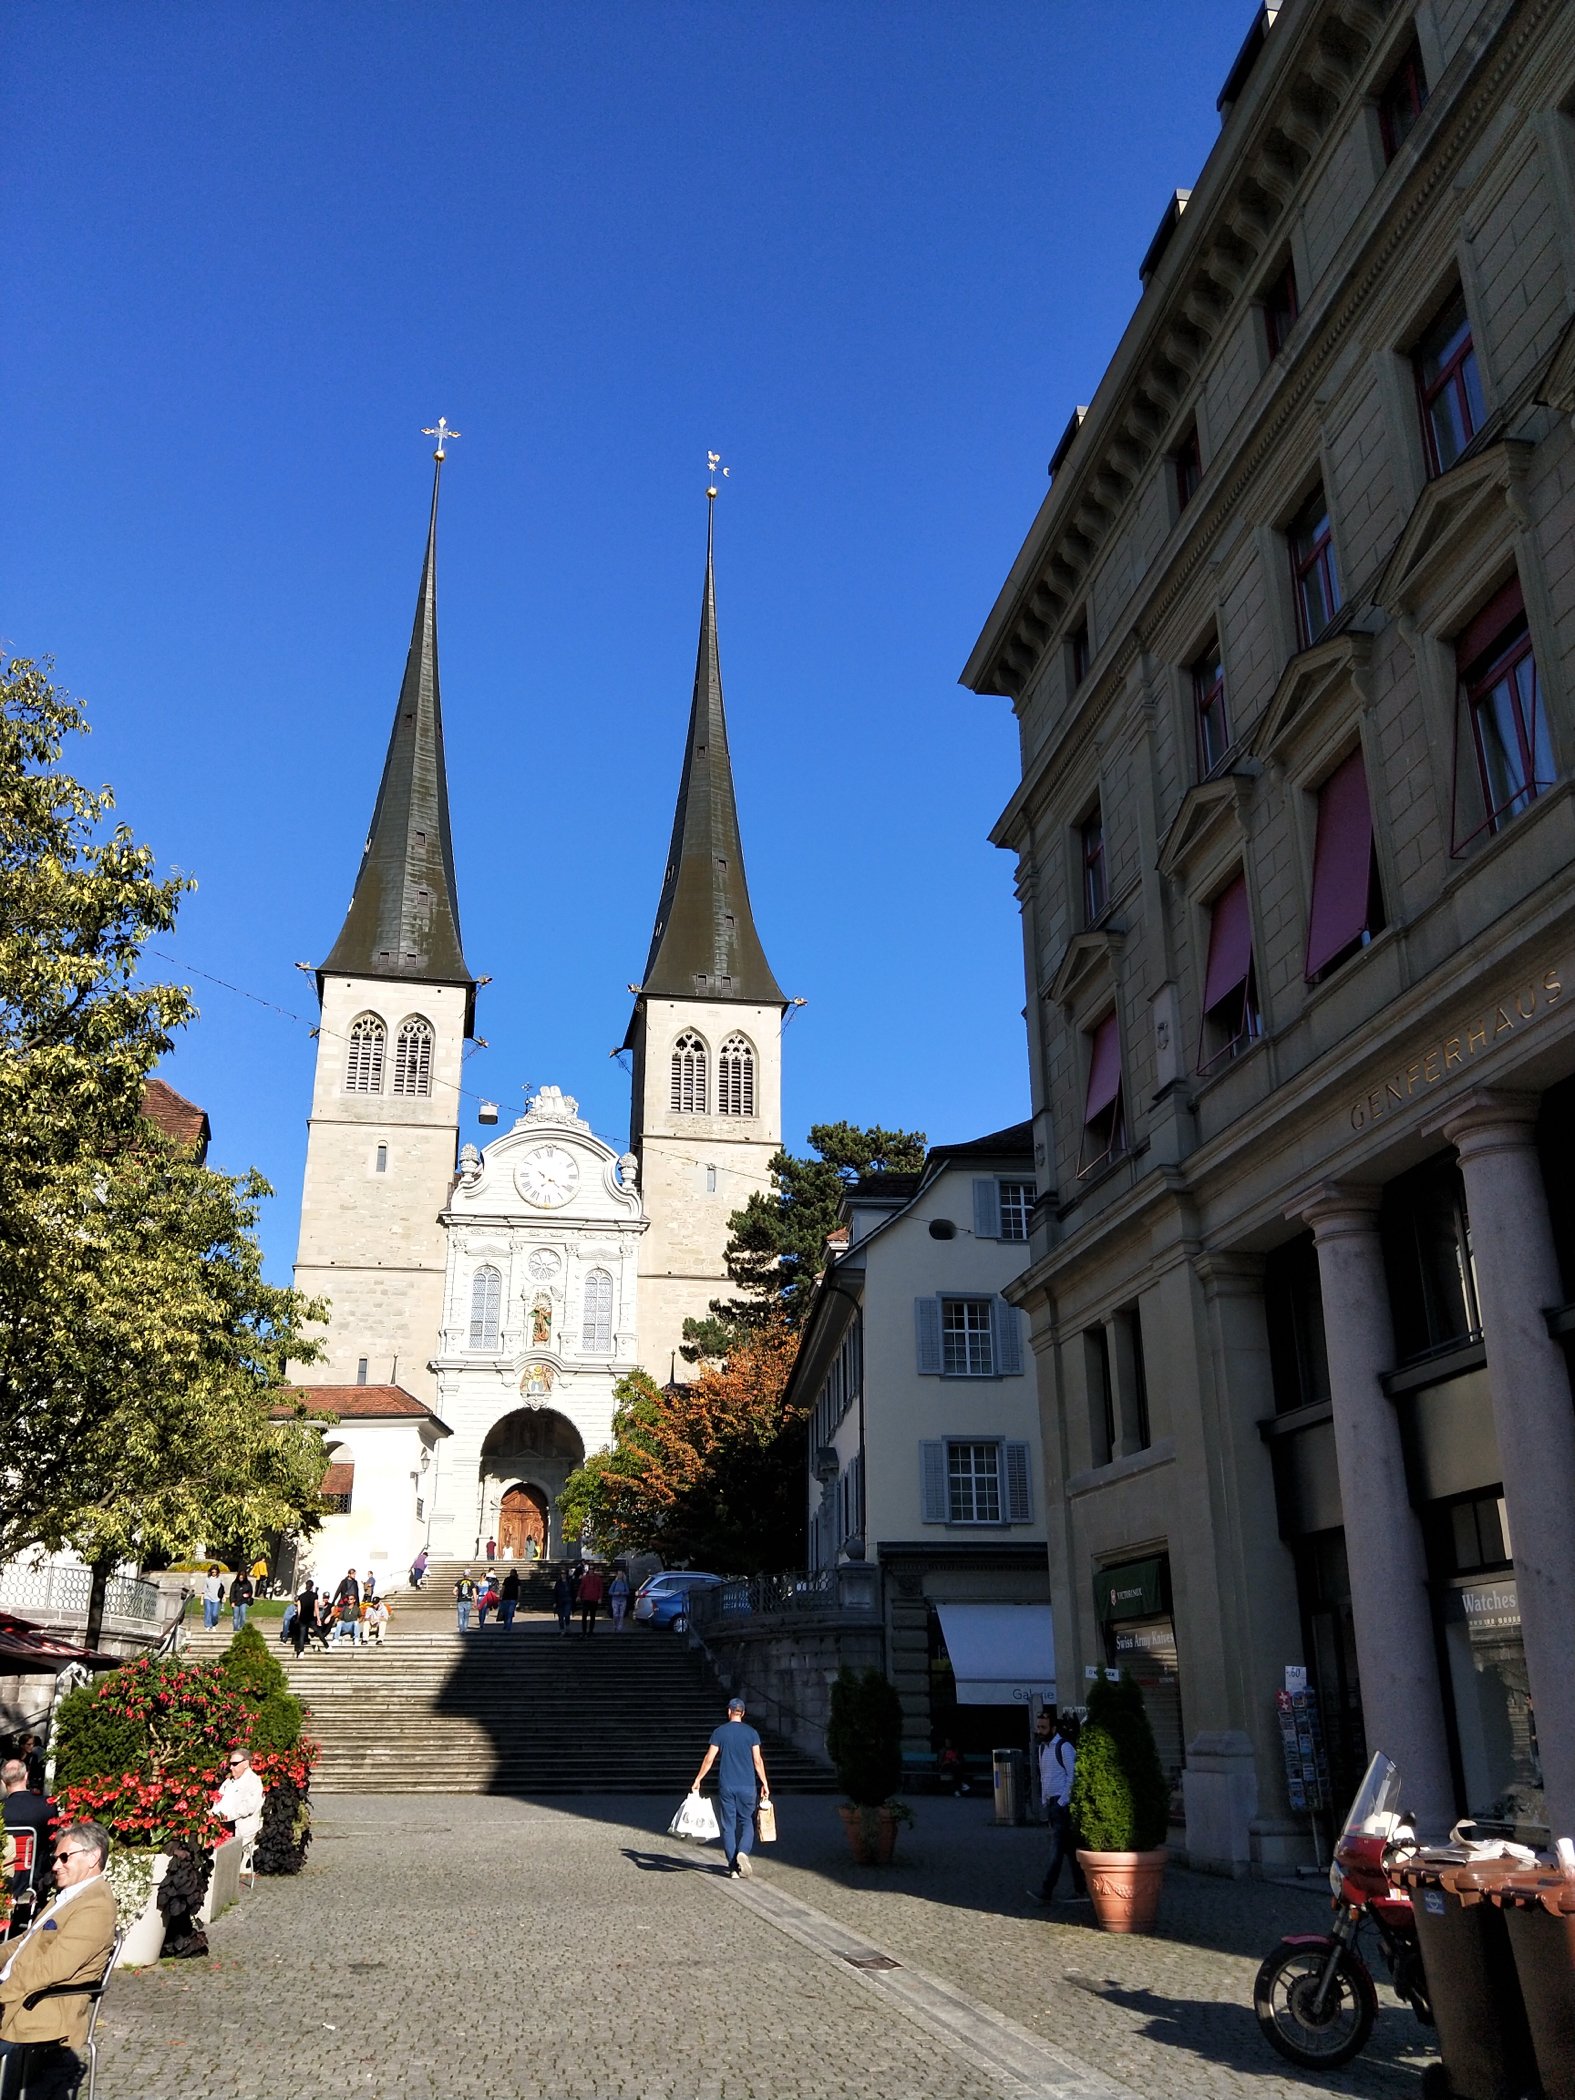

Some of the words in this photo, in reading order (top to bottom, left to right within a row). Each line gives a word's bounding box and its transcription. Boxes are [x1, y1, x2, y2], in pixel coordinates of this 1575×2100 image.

[1350, 970, 1563, 1130] GENFERHAUS
[1462, 1590, 1516, 1613] Watches
[1116, 1635, 1133, 1650] Swiss
[1134, 1633, 1151, 1649] Army
[1152, 1631, 1174, 1645] Knives
